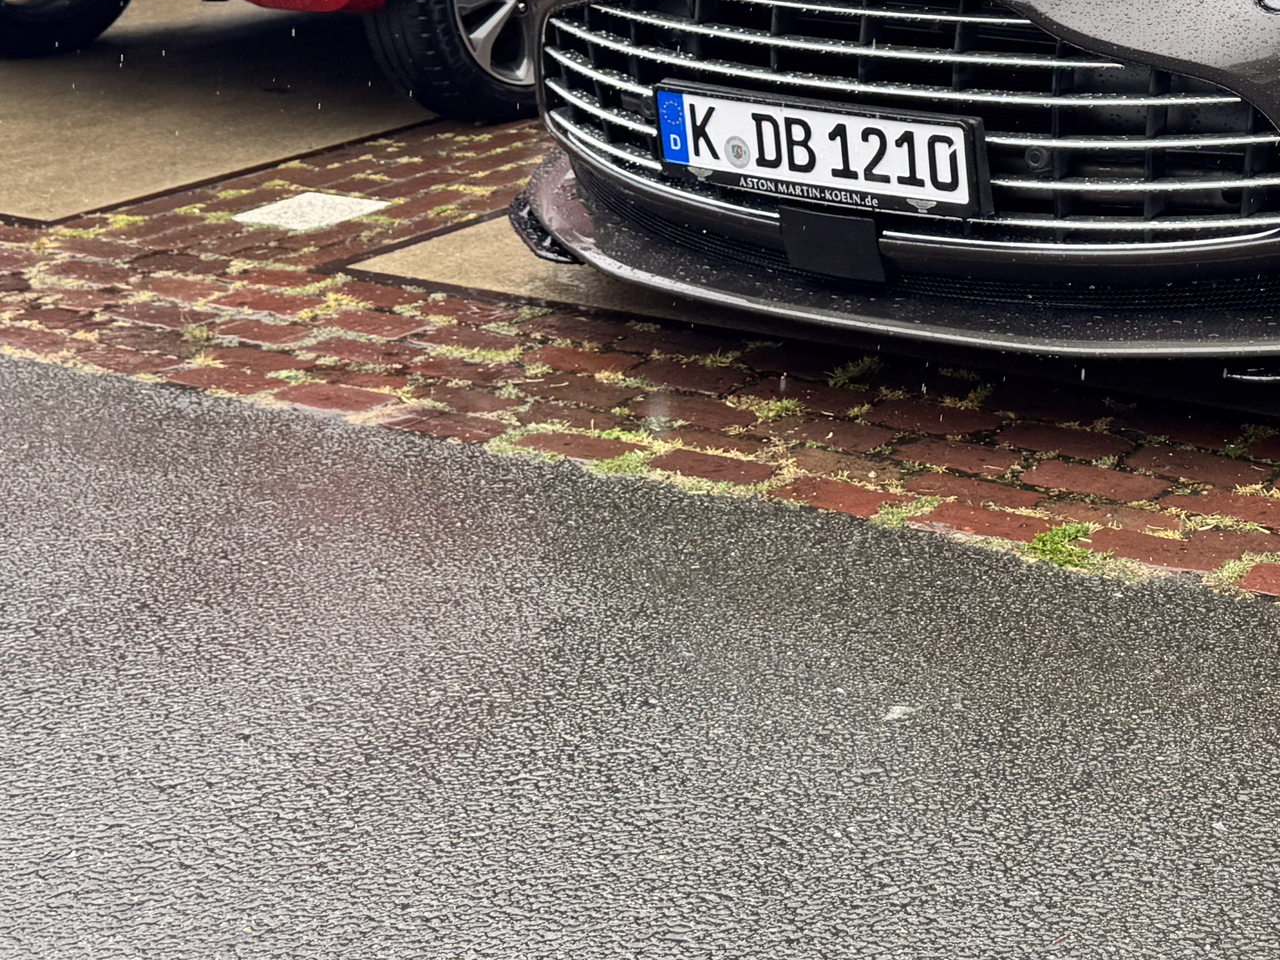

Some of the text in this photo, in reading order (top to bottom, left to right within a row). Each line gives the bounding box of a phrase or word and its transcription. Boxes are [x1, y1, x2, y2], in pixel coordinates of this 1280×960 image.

[669, 133, 682, 151] D
[688, 103, 720, 161] K
[828, 122, 960, 193] 1210
[739, 176, 776, 192] ASTON
